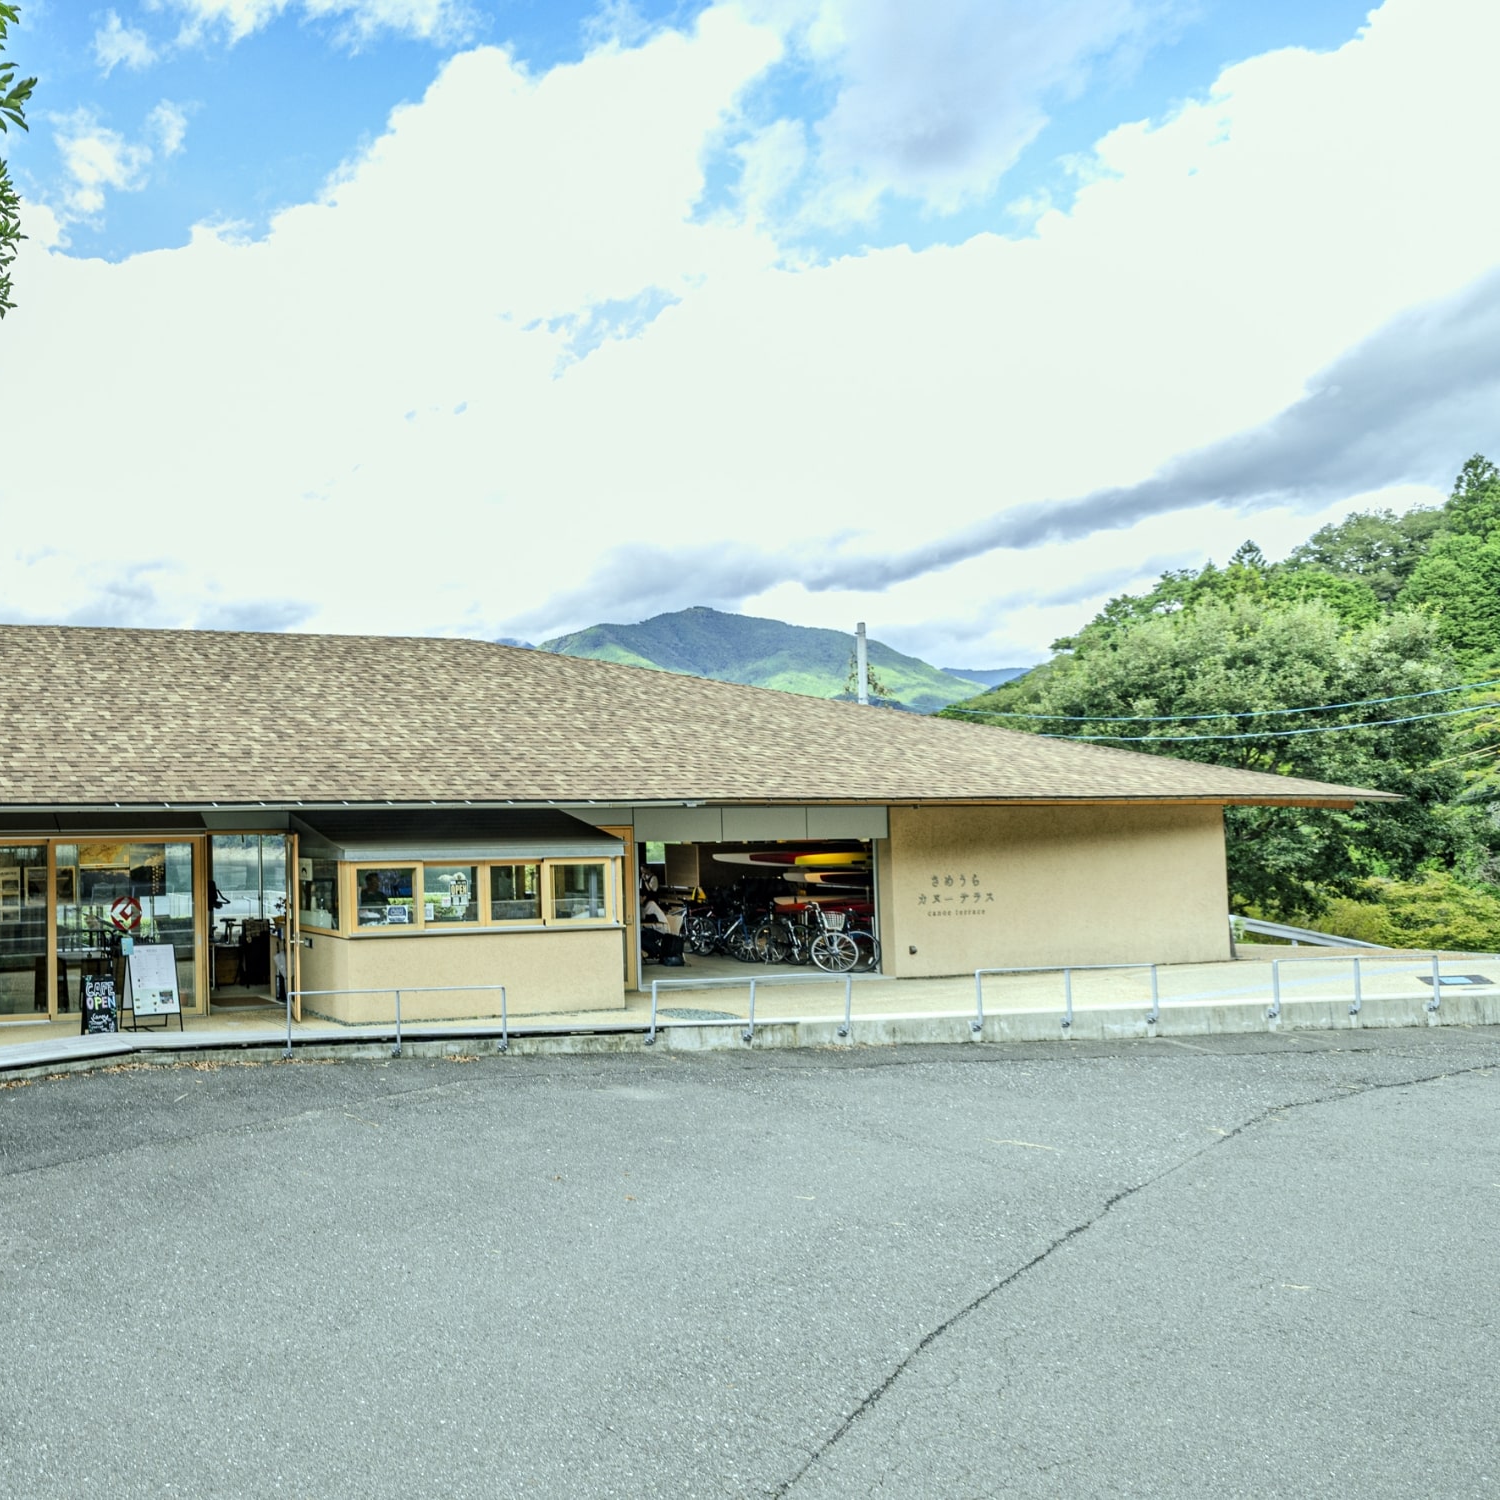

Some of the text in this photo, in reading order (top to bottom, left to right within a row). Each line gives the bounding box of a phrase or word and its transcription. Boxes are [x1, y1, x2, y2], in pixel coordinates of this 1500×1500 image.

[931, 874, 980, 888] さめうら
[918, 892, 994, 905] カヌーテラス
[86, 981, 115, 997] CAFE
[86, 996, 116, 1010] OPEN
